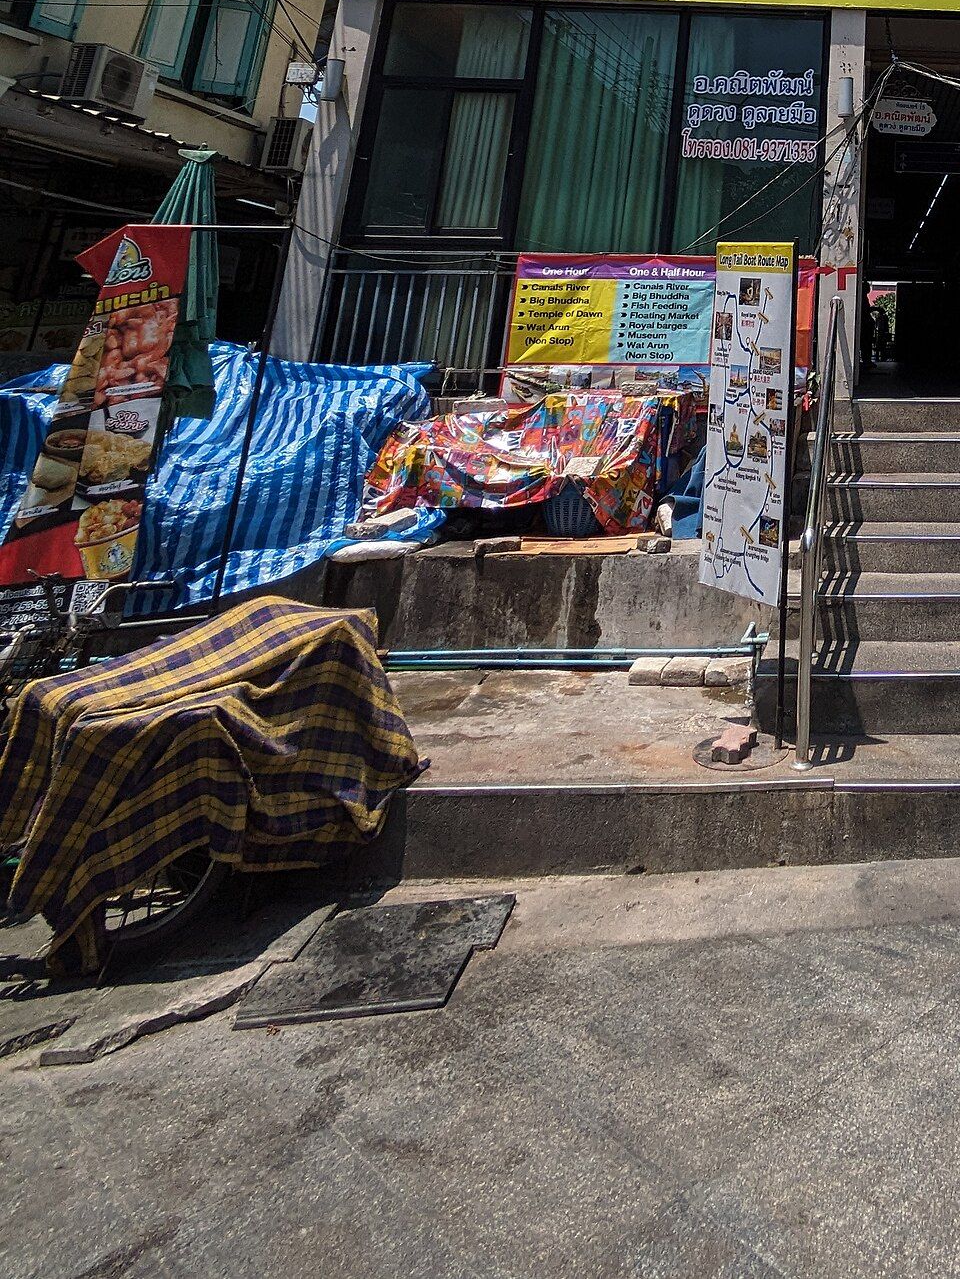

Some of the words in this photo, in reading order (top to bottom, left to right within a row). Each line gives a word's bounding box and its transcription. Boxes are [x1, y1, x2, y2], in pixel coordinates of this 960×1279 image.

[694, 69, 814, 96] อ.คณิตพัฒน์
[687, 104, 736, 128] ดูดวง
[742, 101, 816, 129] ดูลายมือ
[720, 253, 732, 269] Long
[733, 253, 743, 266] Tail
[744, 253, 757, 266] Boat
[757, 254, 775, 267] Route
[776, 255, 789, 270] Map
[542, 267, 564, 276] One
[565, 267, 590, 276] Hour
[629, 267, 650, 277] One
[651, 268, 659, 276] &
[660, 267, 681, 277] Half
[681, 268, 706, 277] Hour
[531, 283, 564, 291] Canals
[566, 283, 590, 291] River
[633, 283, 664, 291] Canals
[666, 283, 690, 291] River
[529, 296, 545, 306] Big
[547, 296, 590, 304] Bhuddha
[632, 292, 647, 302] Big
[649, 292, 690, 300] Bhuddha
[631, 302, 650, 310] Fish
[652, 302, 688, 312] Feeding
[528, 310, 564, 319] Temple
[576, 310, 603, 318] Dawn
[630, 312, 666, 321] Floating
[667, 312, 700, 320] Market
[526, 323, 547, 331] Wat
[548, 323, 570, 331] Arun
[629, 321, 655, 331] Royal
[656, 322, 688, 331] barges
[627, 332, 667, 340] Museum
[525, 336, 548, 346] (Non
[548, 336, 574, 347] Stop)
[626, 341, 645, 349] Wat
[647, 341, 669, 349] Arun
[625, 351, 648, 361] (Non
[649, 351, 674, 361] Stop)
